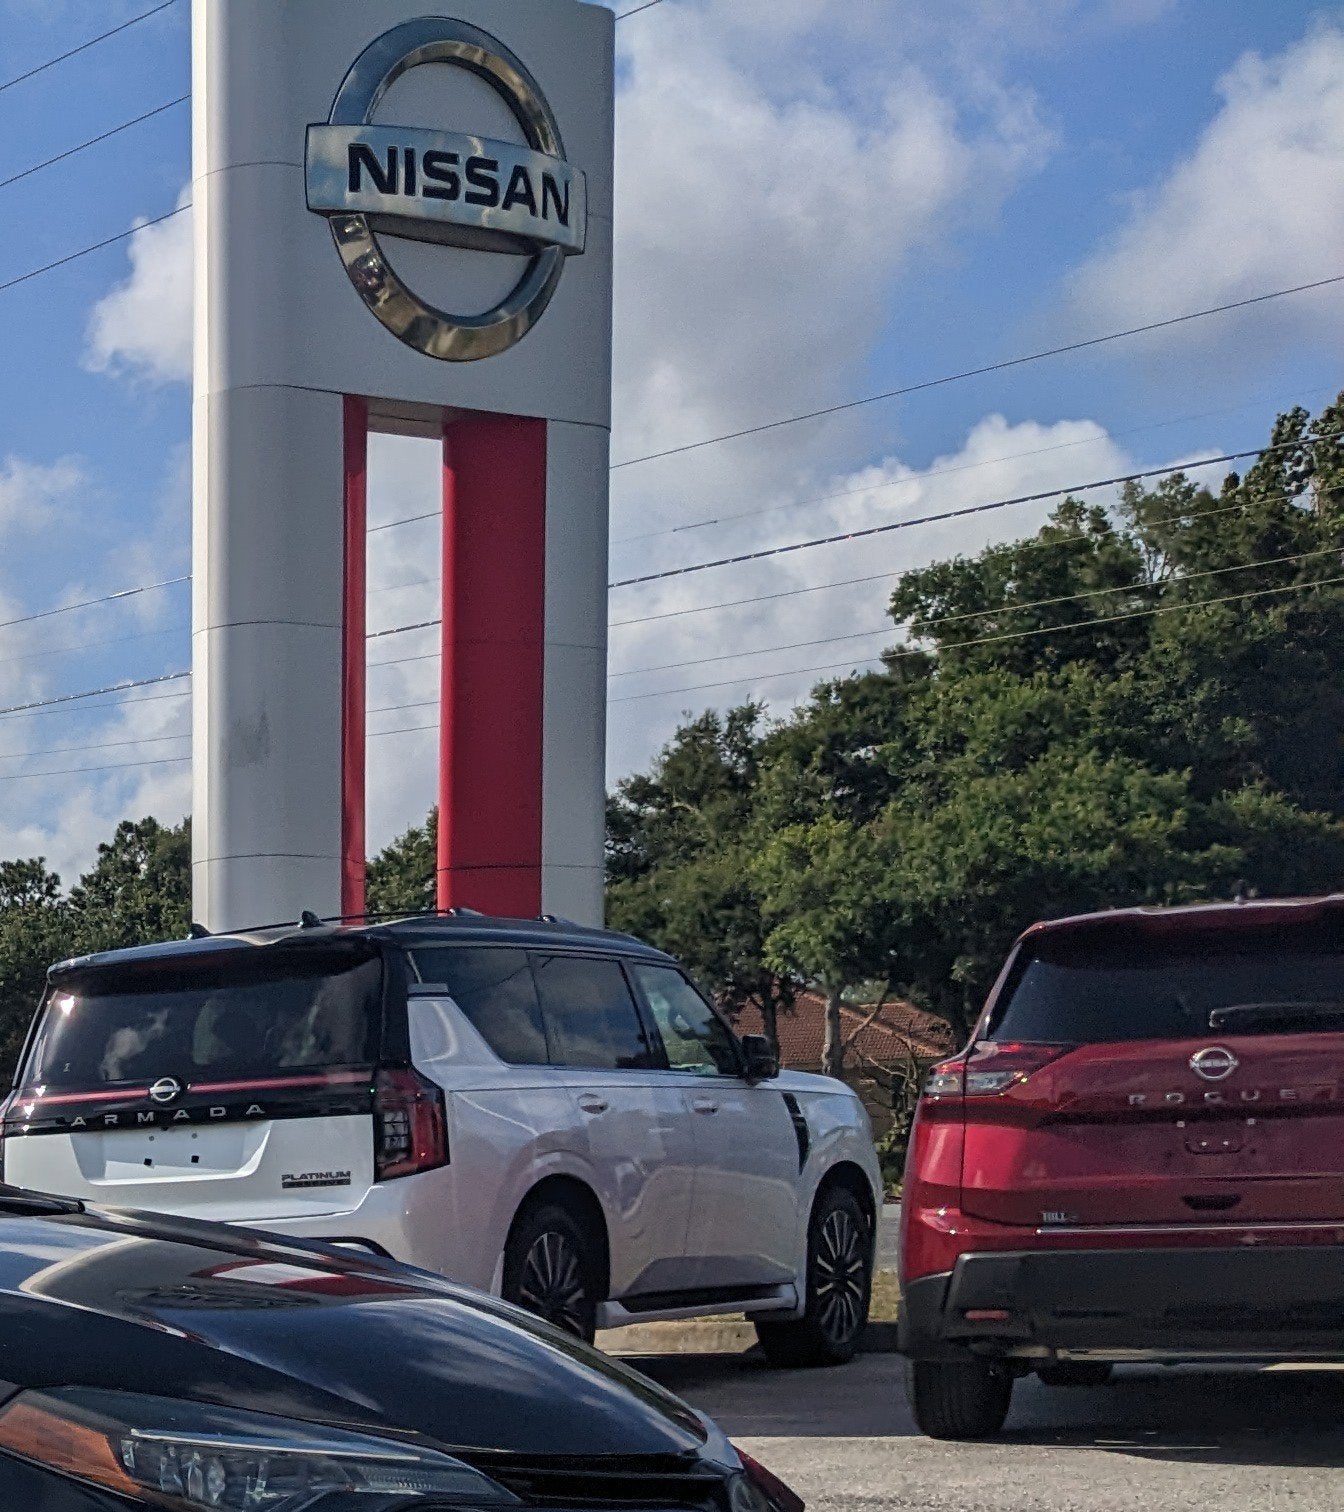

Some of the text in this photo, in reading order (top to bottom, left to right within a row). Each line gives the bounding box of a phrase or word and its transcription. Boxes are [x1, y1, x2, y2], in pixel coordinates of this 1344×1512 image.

[347, 142, 569, 228] NISSAN
[1128, 1088, 1297, 1105] ROGUE
[71, 1104, 265, 1127] ARMADA
[281, 1170, 351, 1181] PLATINUM
